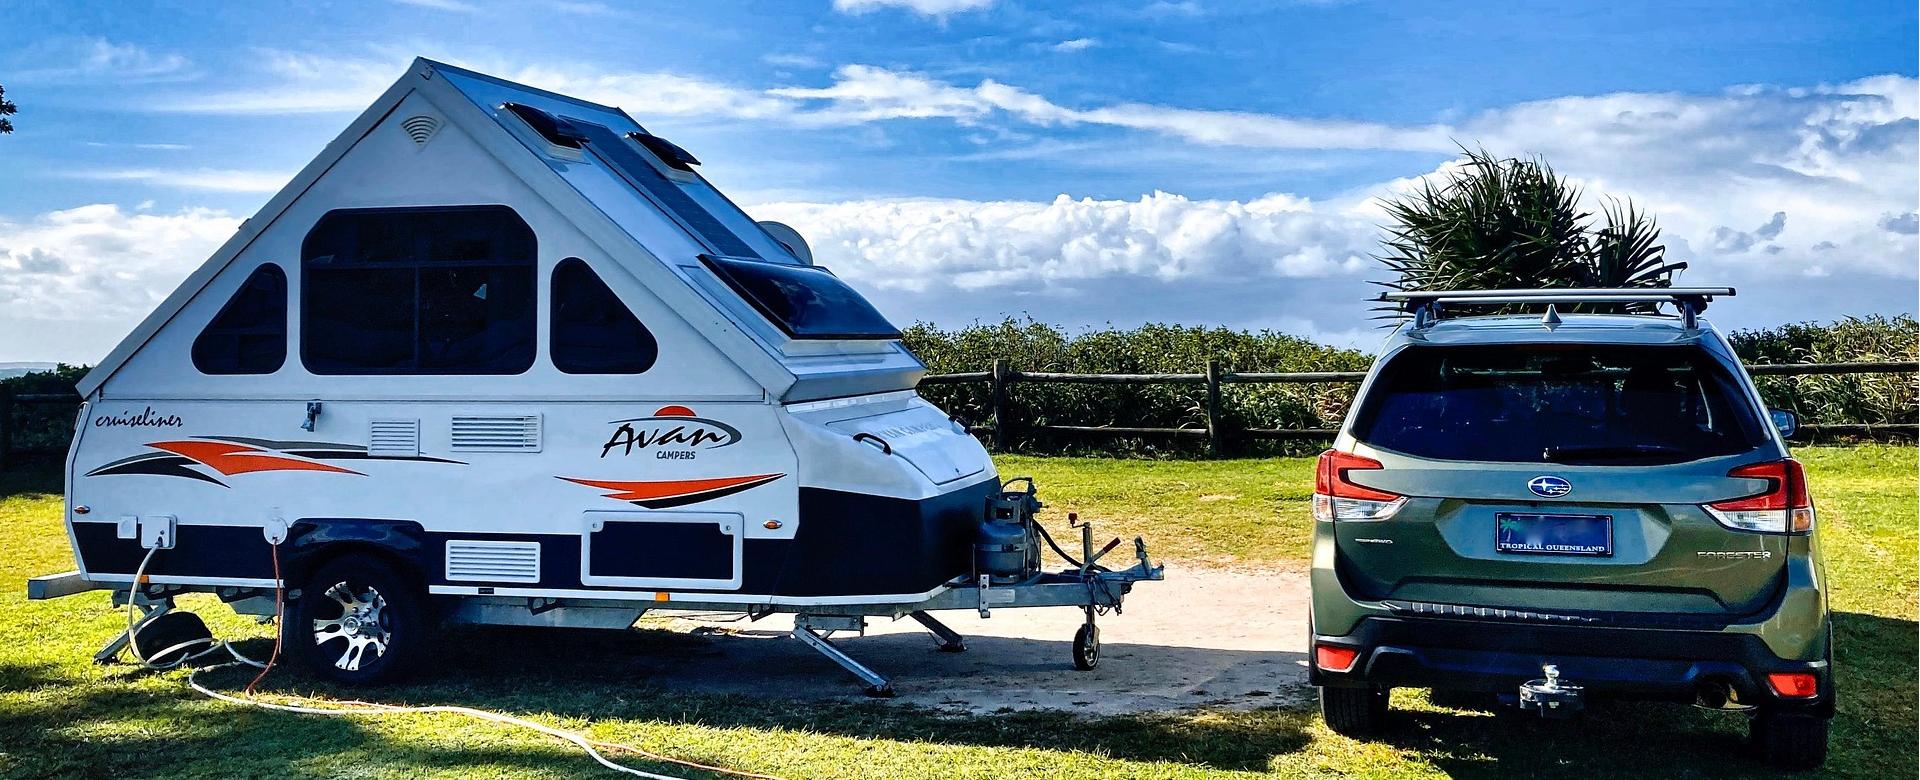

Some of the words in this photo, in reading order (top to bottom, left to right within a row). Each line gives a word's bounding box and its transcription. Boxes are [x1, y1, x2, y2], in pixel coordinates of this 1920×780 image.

[95, 406, 183, 428] cruiseliner
[656, 450, 697, 460] CAMPERS
[1546, 544, 1605, 552] QUEENSLAND
[1697, 551, 1772, 560] FORESTER
